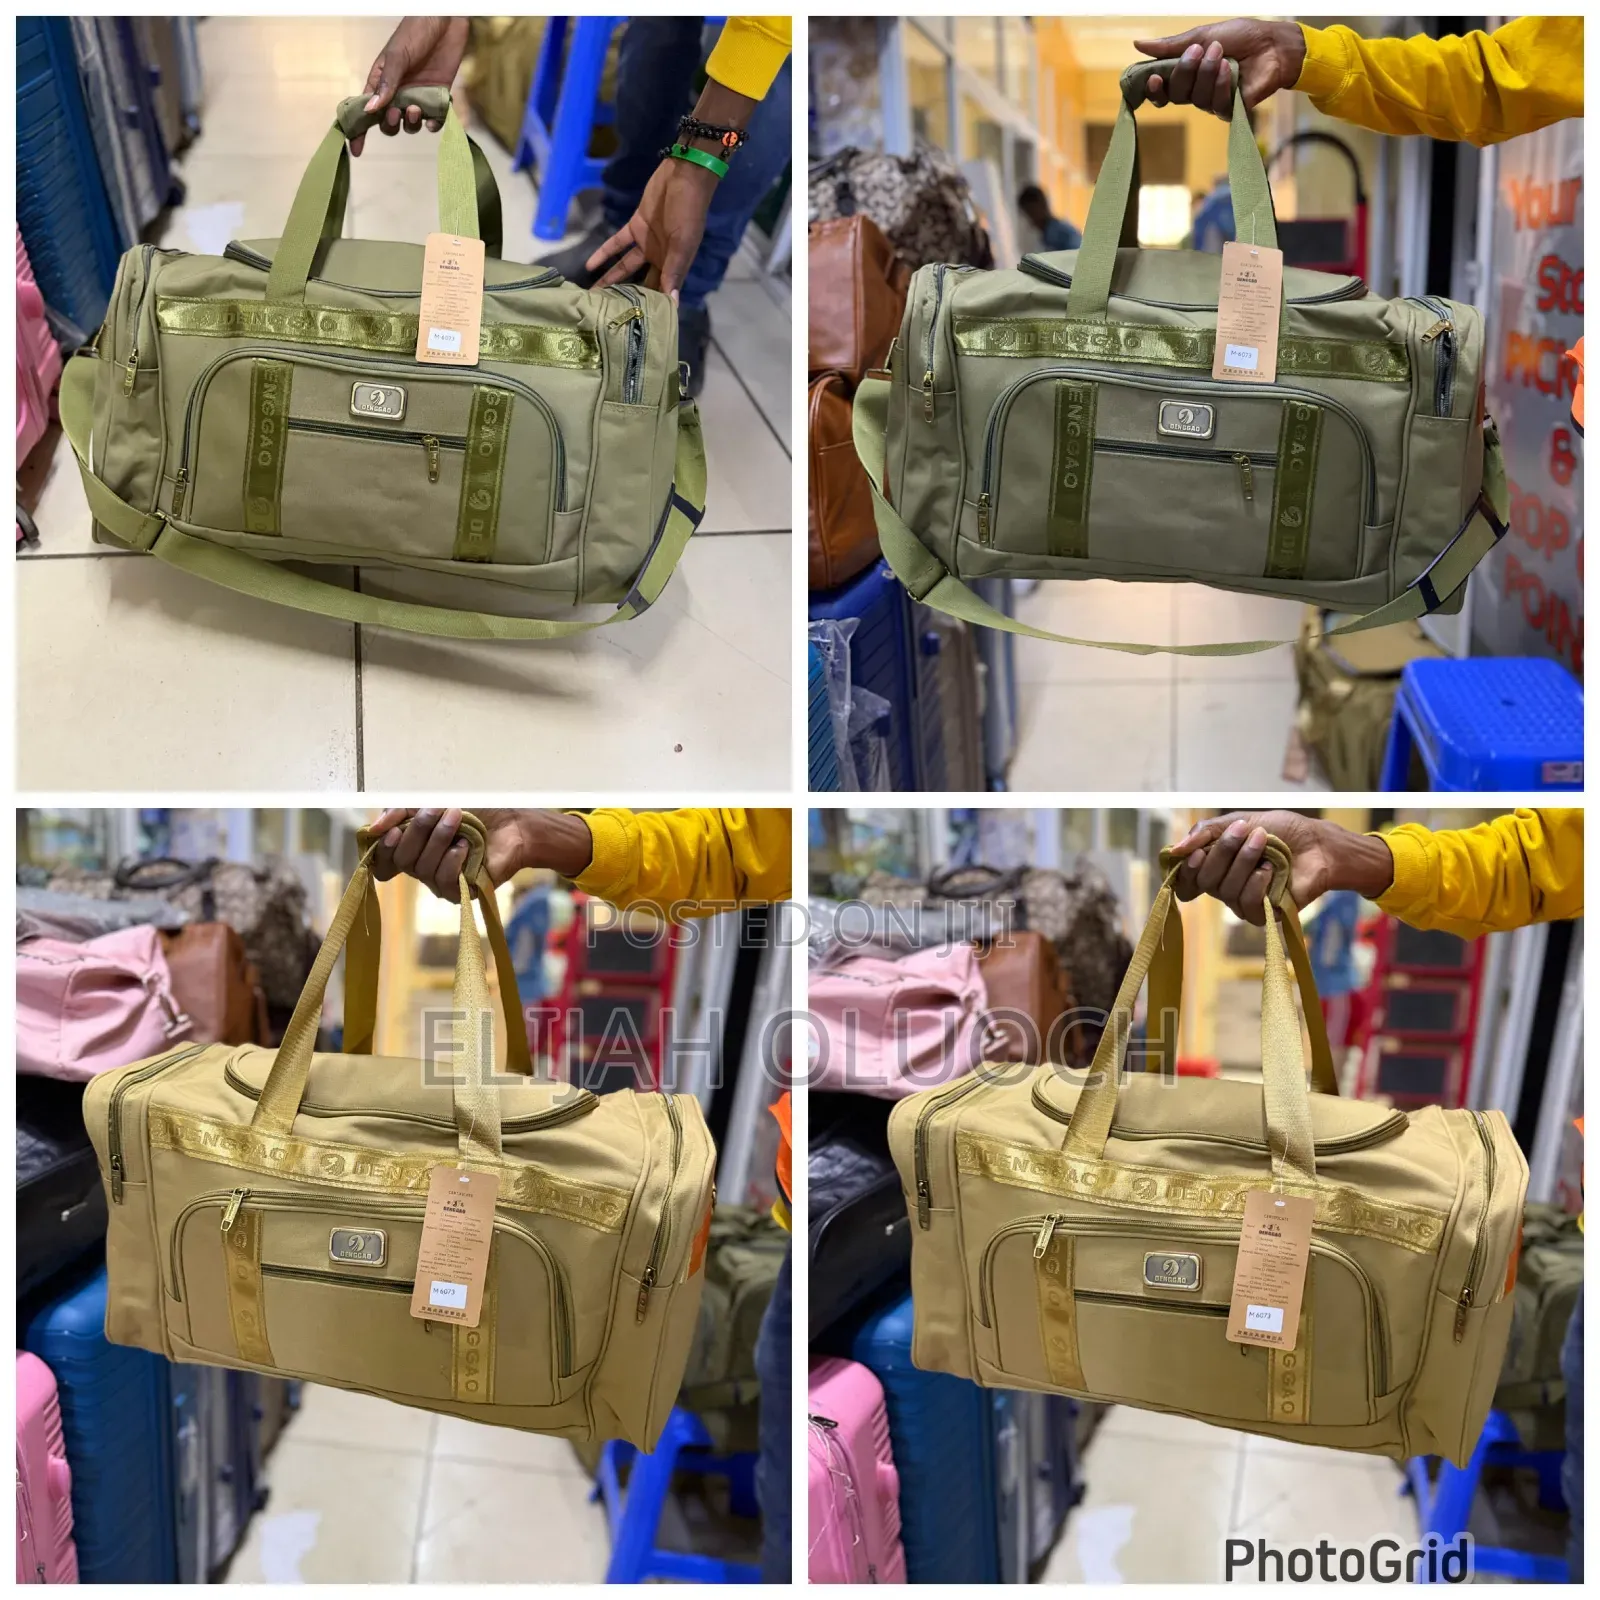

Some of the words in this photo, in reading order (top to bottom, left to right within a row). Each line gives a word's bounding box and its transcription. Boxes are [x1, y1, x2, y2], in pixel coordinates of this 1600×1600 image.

[361, 404, 392, 414] DENGGAO
[1169, 423, 1201, 432] DENGGAO
[340, 1250, 372, 1260] DENGGAO
[1154, 1275, 1187, 1284] DENGGAO
